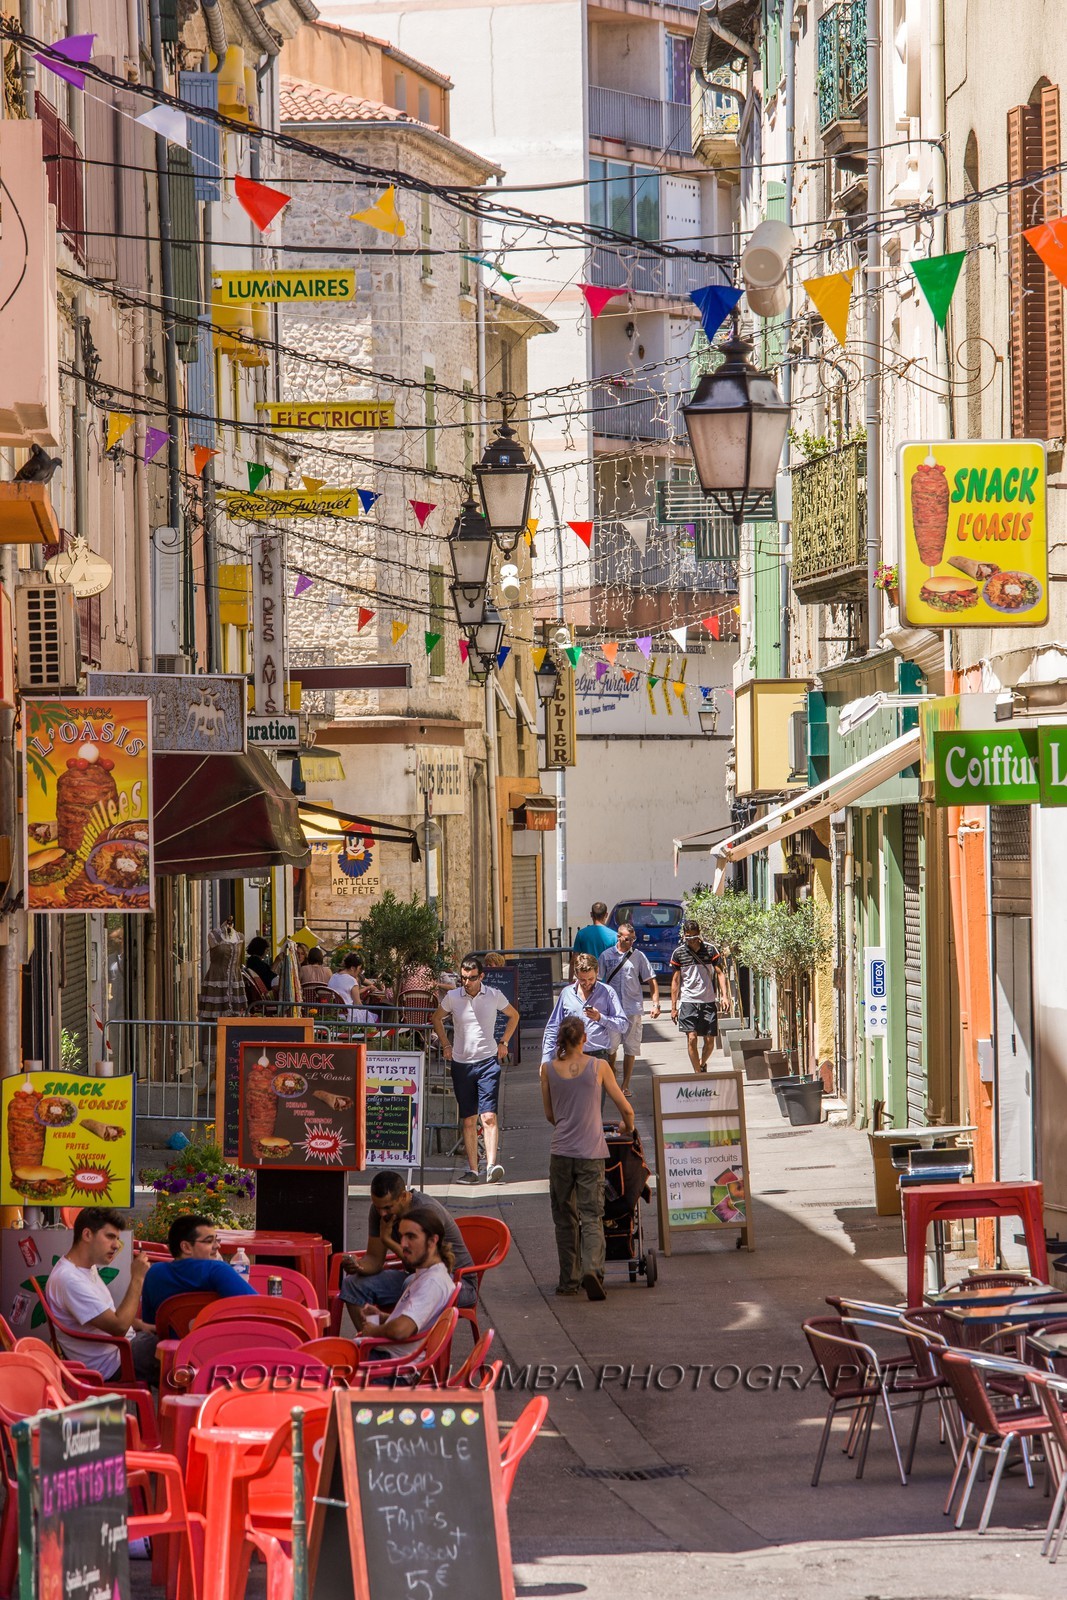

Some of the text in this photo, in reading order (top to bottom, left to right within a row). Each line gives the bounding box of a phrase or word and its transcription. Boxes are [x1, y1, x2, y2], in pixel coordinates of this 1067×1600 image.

[228, 279, 349, 298] LUMINAIRES
[950, 467, 1039, 505] SNACK
[956, 512, 1034, 541] L'OASIS
[260, 539, 276, 585] BAR
[84, 583, 104, 596] JUSTICE
[262, 598, 276, 642] DES
[262, 654, 278, 713] AMIS
[66, 707, 114, 720] SNACK
[31, 720, 146, 757] L'OASIS
[332, 877, 379, 886] ARTICLES
[336, 887, 348, 895] DE
[873, 962, 885, 994] durex
[275, 1052, 335, 1070] SNACK
[42, 1082, 106, 1097] SNACK
[676, 1086, 721, 1099] Melvita
[78, 1099, 128, 1111] L'OASIS
[65, 1142, 90, 1150] FRITES
[668, 1152, 738, 1166] Tous les produits
[669, 1168, 703, 1177] Melvita
[669, 1179, 706, 1189] en vente
[670, 1192, 682, 1201] ici
[671, 1211, 708, 1222] OUVERT
[365, 1434, 472, 1464] FORMULE
[42, 1455, 126, 1517] L'ARTISTE
[368, 1468, 444, 1496] KEBAB
